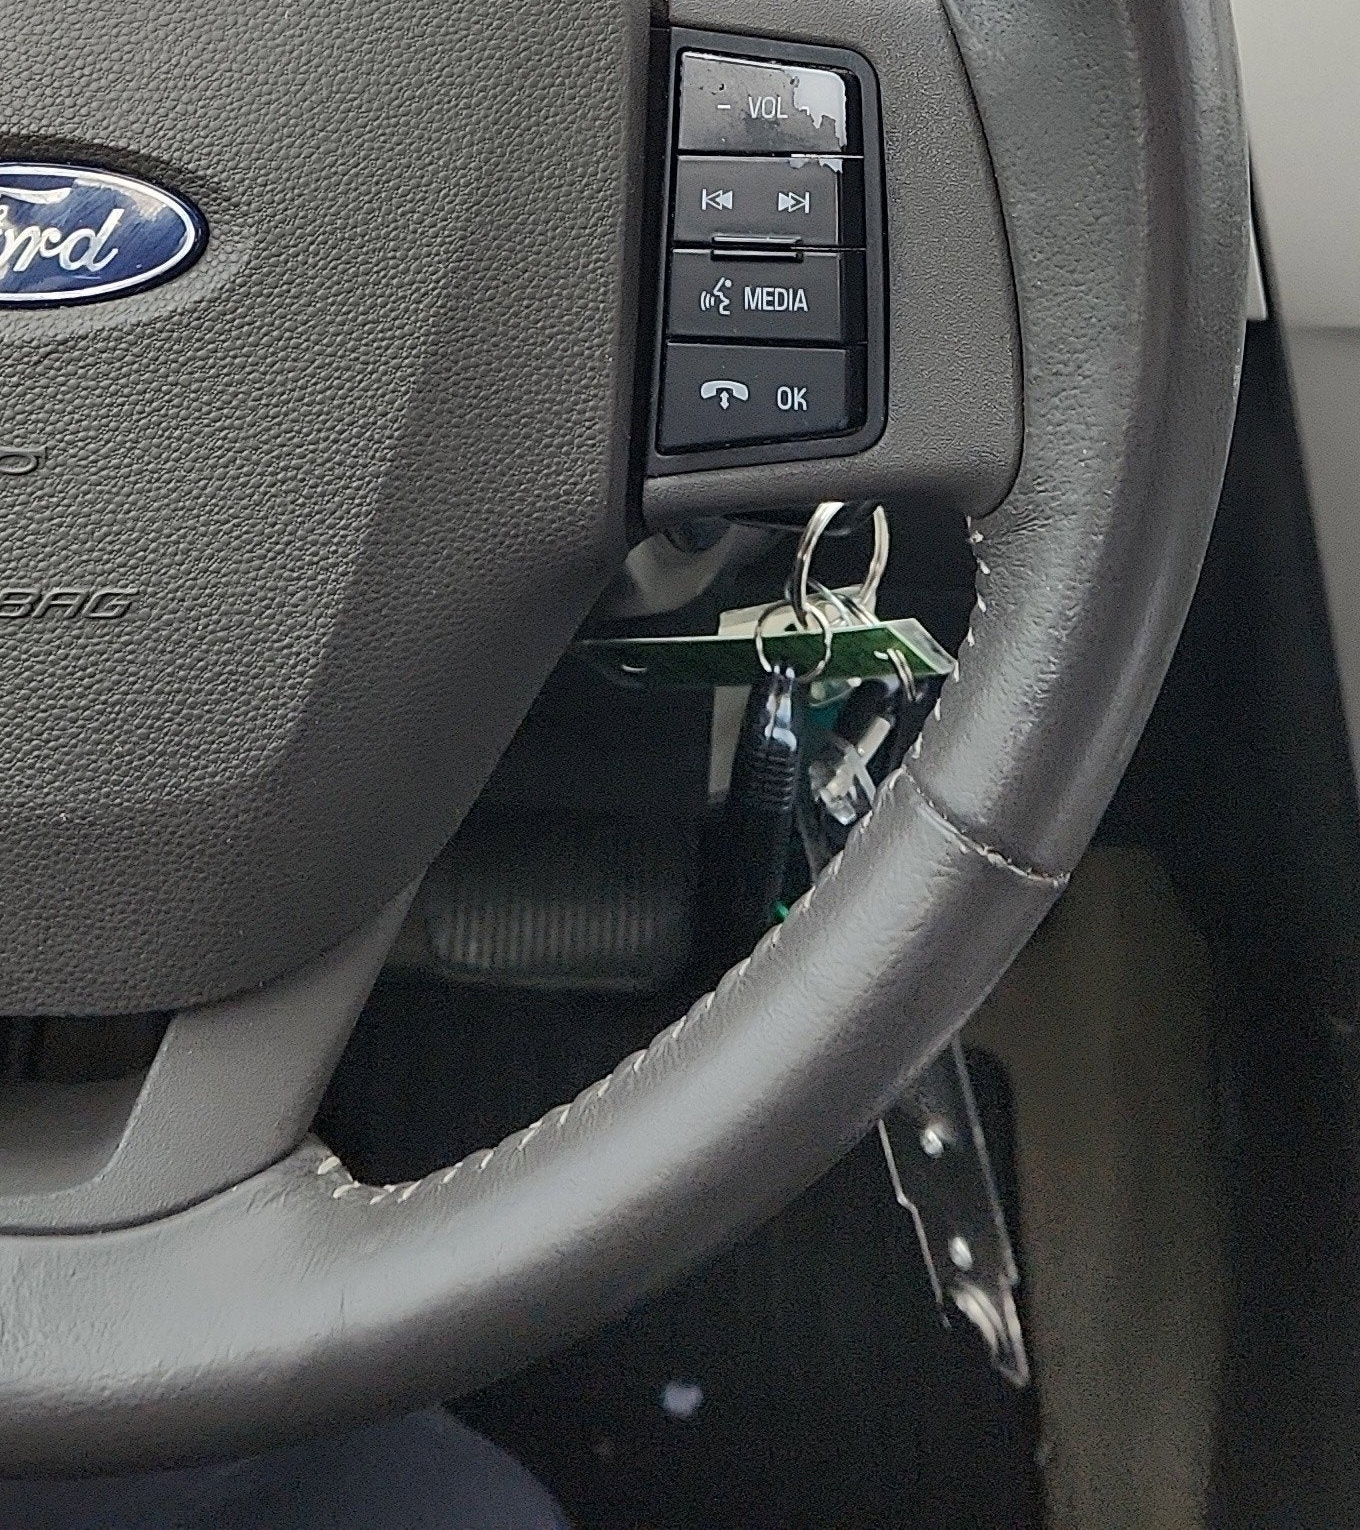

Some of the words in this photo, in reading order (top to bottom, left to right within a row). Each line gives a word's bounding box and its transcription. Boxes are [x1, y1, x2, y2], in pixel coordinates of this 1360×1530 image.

[748, 96, 789, 119] VOL
[743, 286, 809, 312] MEDIA
[777, 386, 808, 411] OK
